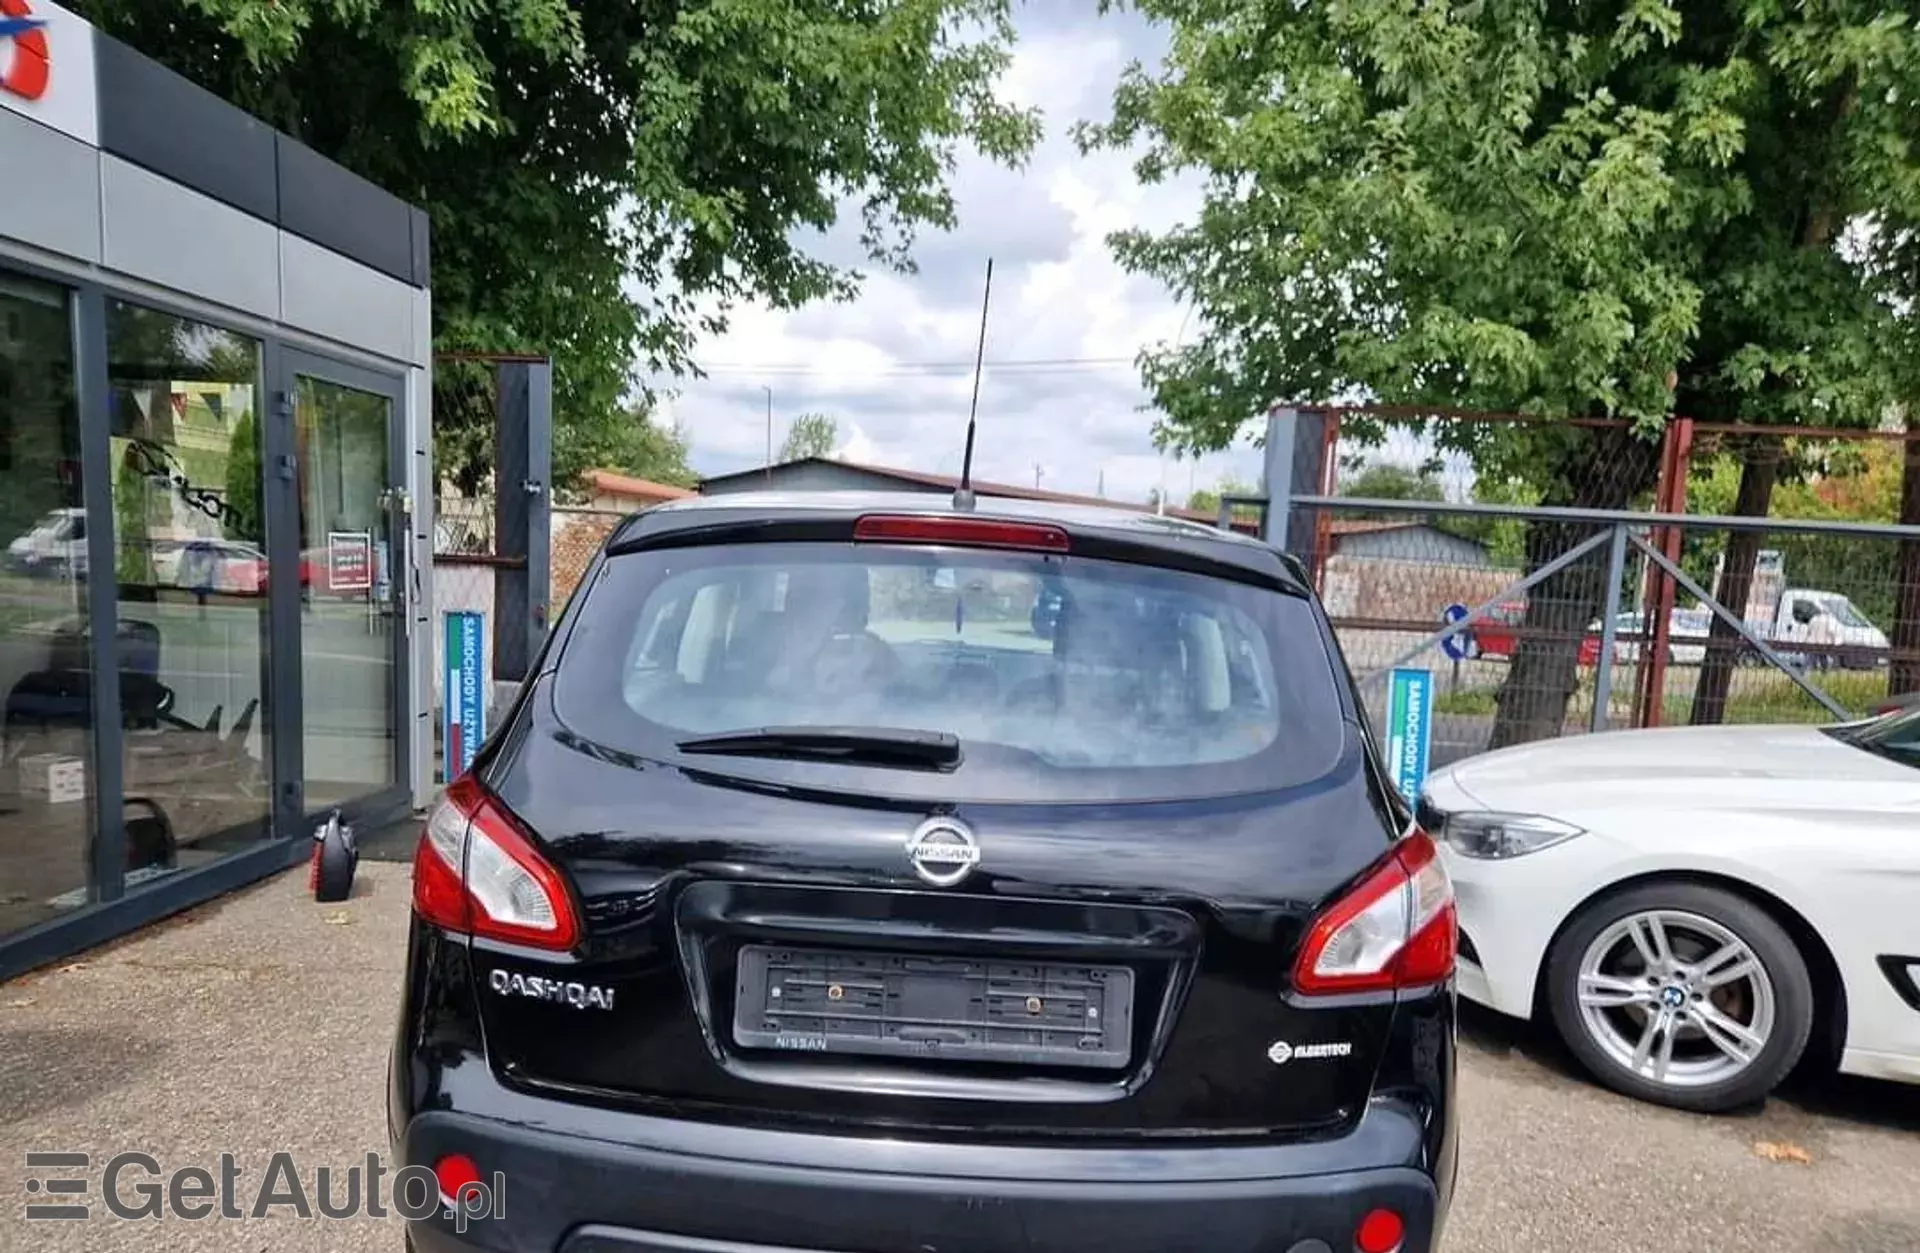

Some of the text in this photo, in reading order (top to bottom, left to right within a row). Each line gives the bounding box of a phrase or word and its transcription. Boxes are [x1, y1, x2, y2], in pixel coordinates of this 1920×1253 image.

[463, 617, 476, 705] SAMOCHODY
[1404, 680, 1422, 774] SAMOCHODY
[911, 846, 973, 859] NISSAN
[490, 969, 615, 1011] QASHQAI
[775, 1037, 827, 1050] NISSAN
